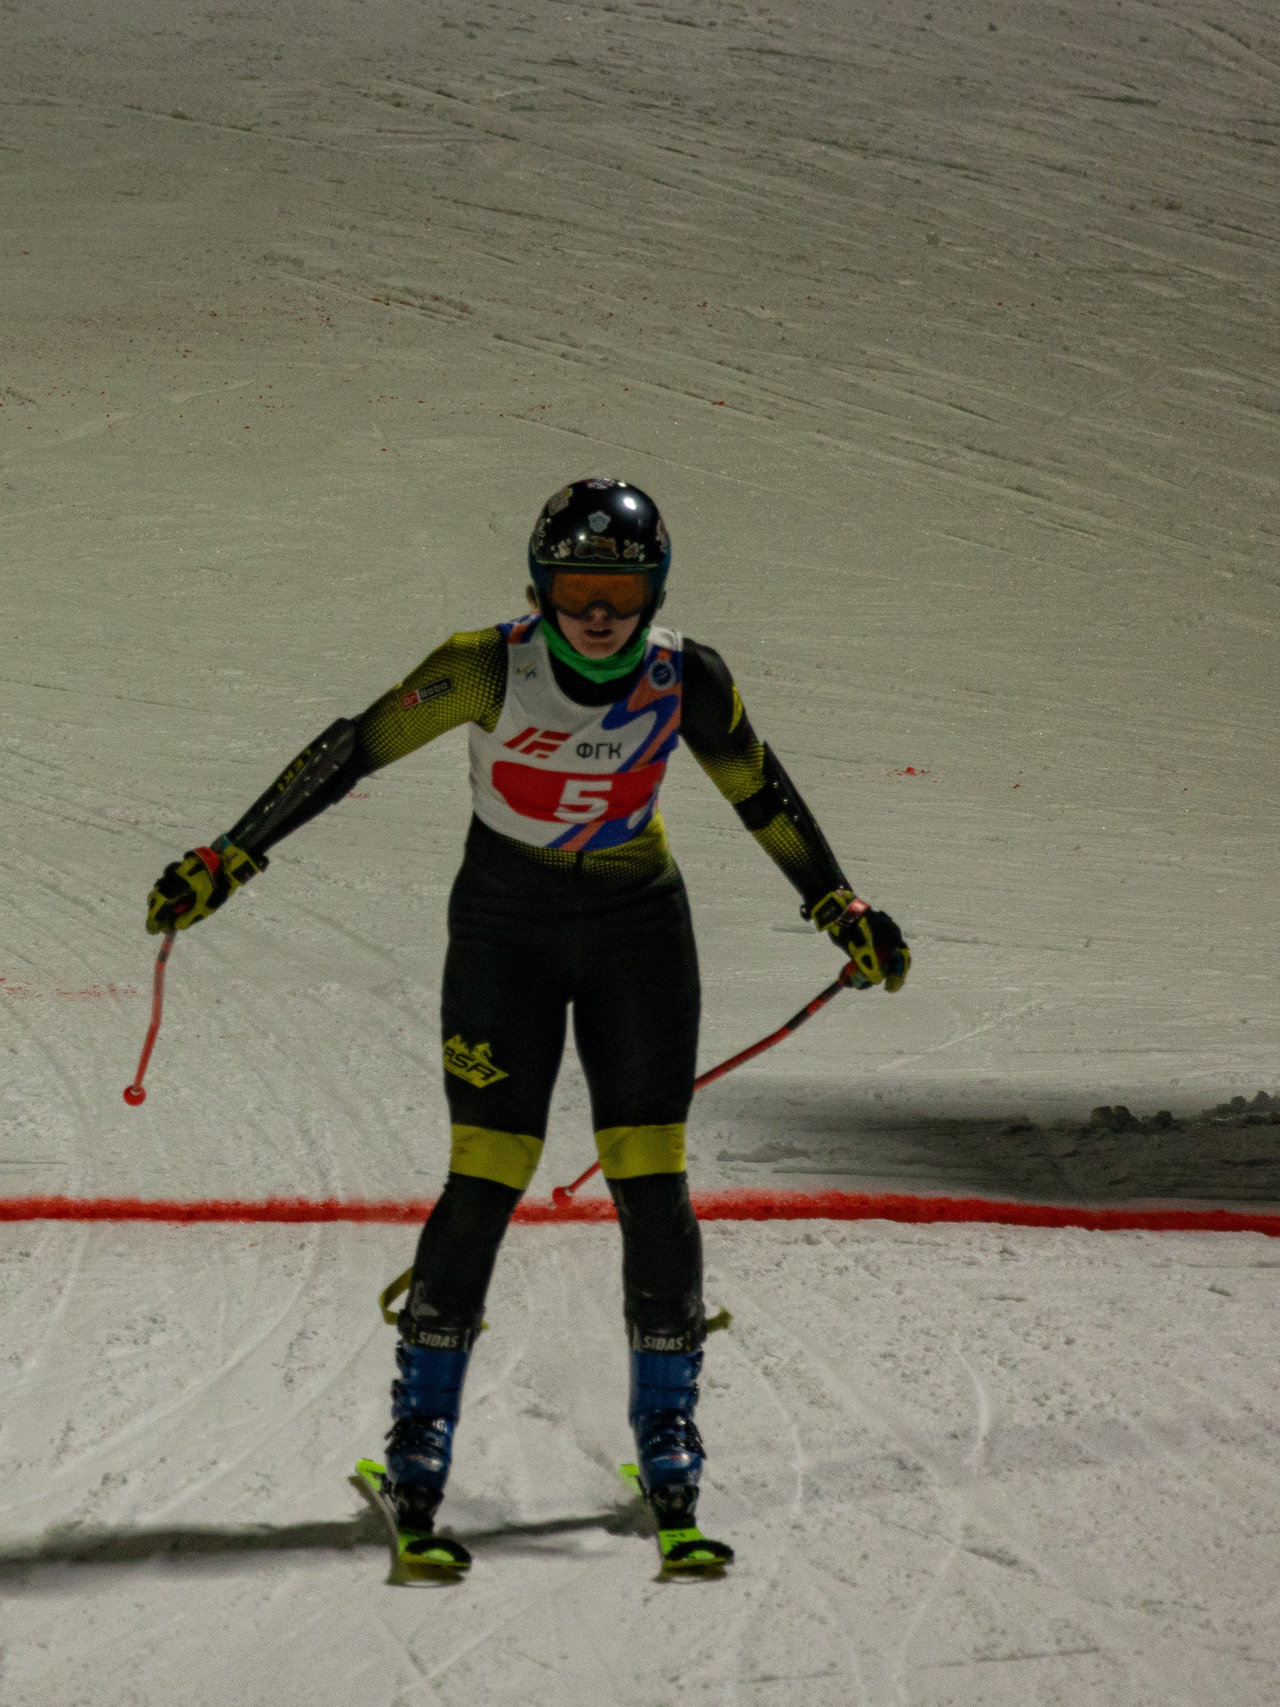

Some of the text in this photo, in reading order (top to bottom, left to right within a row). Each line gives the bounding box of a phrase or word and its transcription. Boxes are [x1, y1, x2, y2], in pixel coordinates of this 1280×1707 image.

[576, 742, 622, 760] ФГК
[553, 778, 614, 824] 5
[418, 1331, 460, 1349] SIDAS
[642, 1335, 685, 1351] SIDAS
